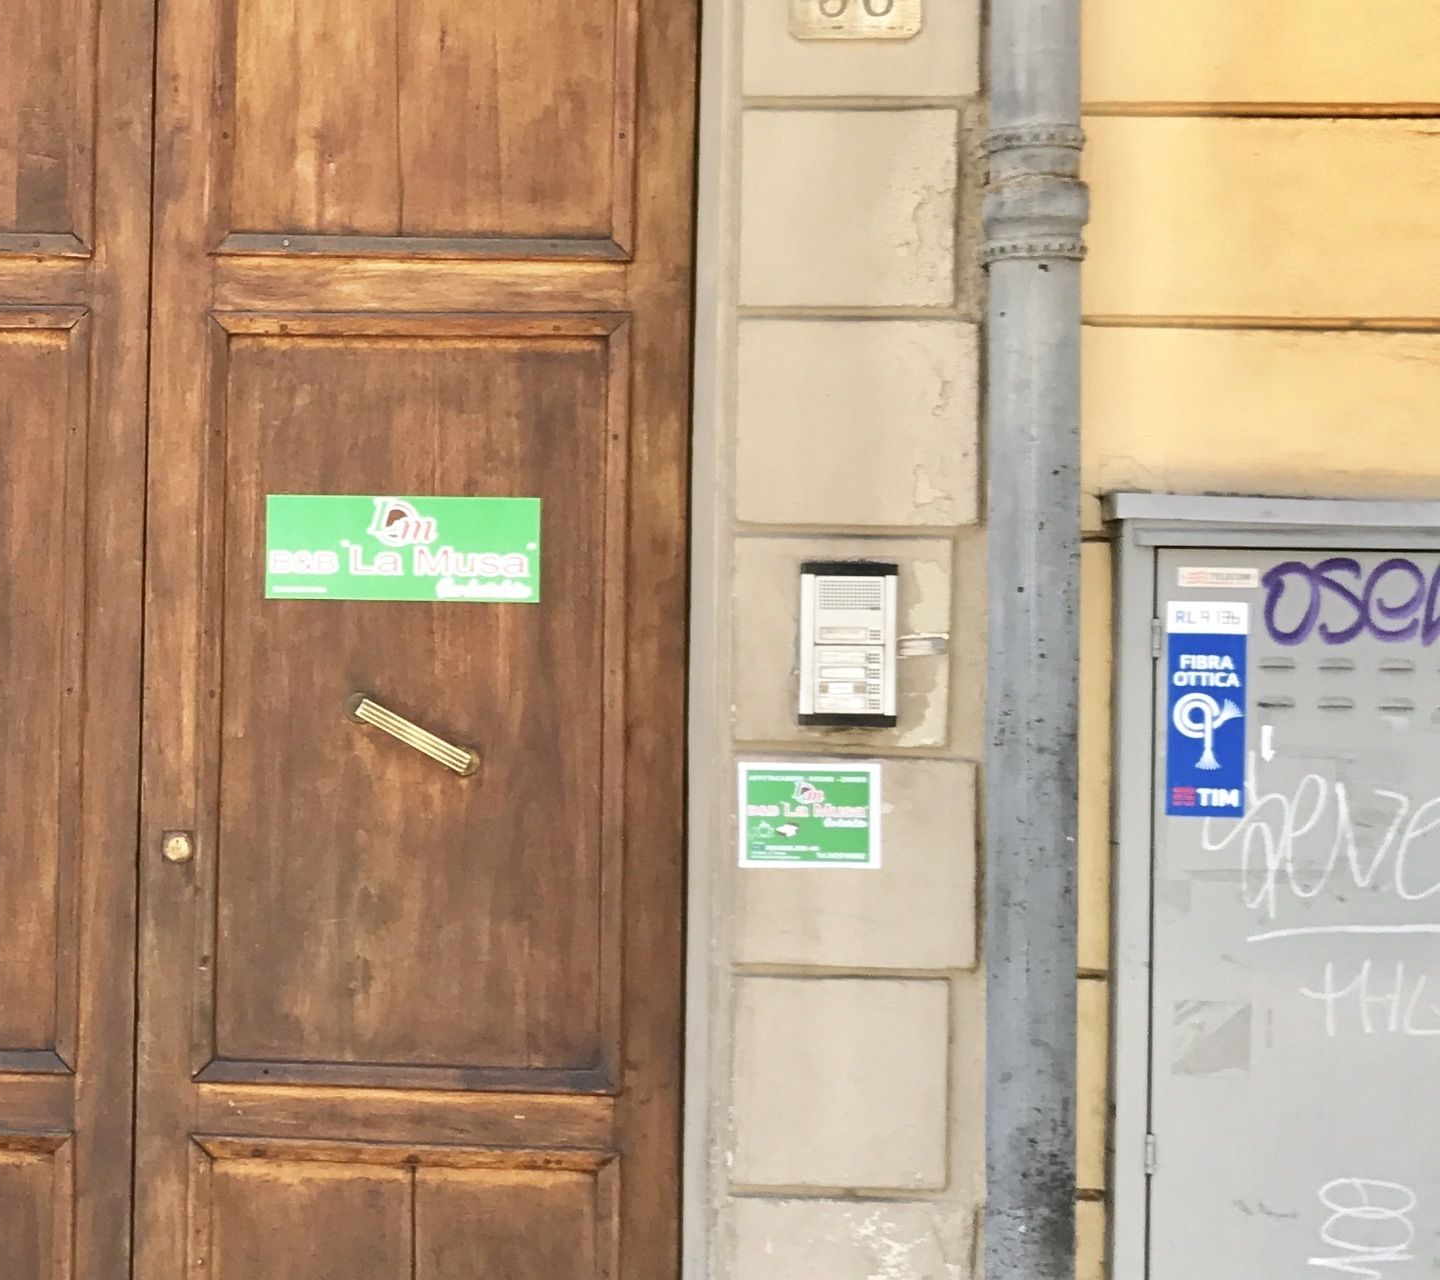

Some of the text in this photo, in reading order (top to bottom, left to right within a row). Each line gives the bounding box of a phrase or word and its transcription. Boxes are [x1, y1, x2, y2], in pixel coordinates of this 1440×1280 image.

[268, 549, 340, 575] B&B
[1179, 654, 1234, 671] FIBRA
[1172, 671, 1242, 688] OTTICA
[1195, 788, 1241, 808] TIM
